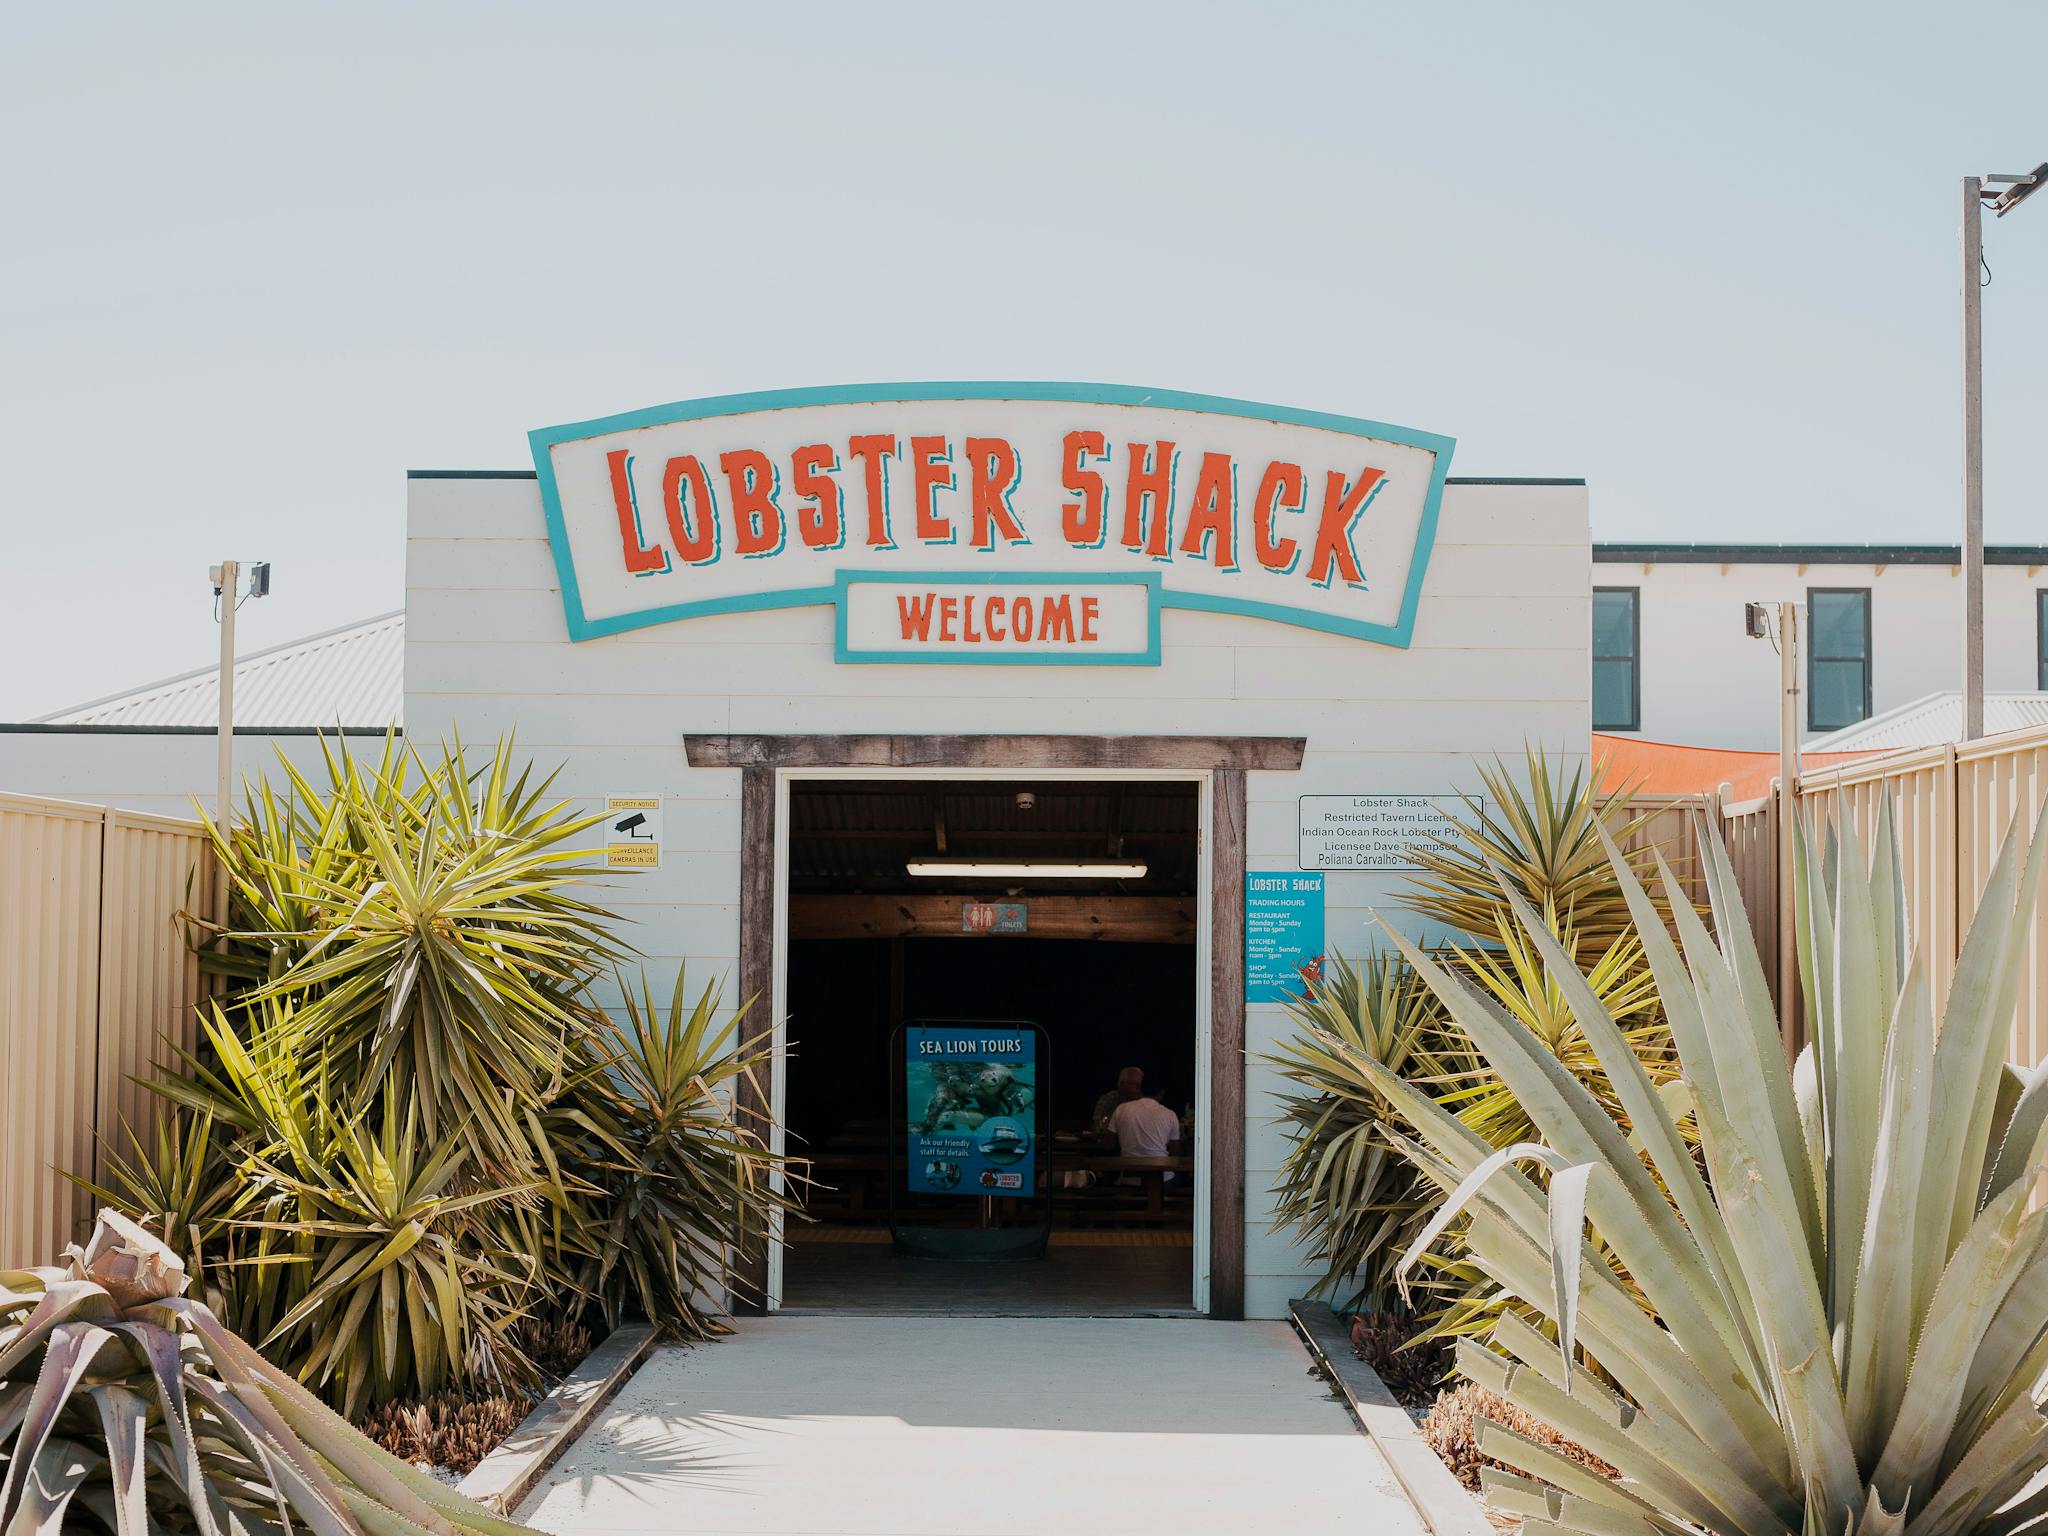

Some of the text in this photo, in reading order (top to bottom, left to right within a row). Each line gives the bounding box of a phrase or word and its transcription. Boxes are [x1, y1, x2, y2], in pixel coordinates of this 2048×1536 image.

[607, 431, 1390, 591] LOBSTER SHACK
[897, 593, 1099, 643] WELCOME
[1353, 798, 1429, 807] Lobster Shack
[1324, 813, 1378, 822] Restricted
[1381, 813, 1415, 822] Tavern
[1302, 827, 1334, 836] Indian
[1337, 827, 1370, 837] Ocean
[1372, 827, 1399, 836] Rock
[1402, 827, 1442, 837] Lobster
[1325, 842, 1371, 851] Licensee
[1374, 842, 1400, 851] Dave
[1318, 853, 1353, 865] Poliana
[1356, 853, 1398, 865] Carvalho
[1249, 878, 1322, 891] LOBSTER SHACK
[1281, 899, 1306, 907] HOURS
[919, 1039, 1022, 1054] SEA LION TOURS
[920, 1138, 931, 1146] Ask
